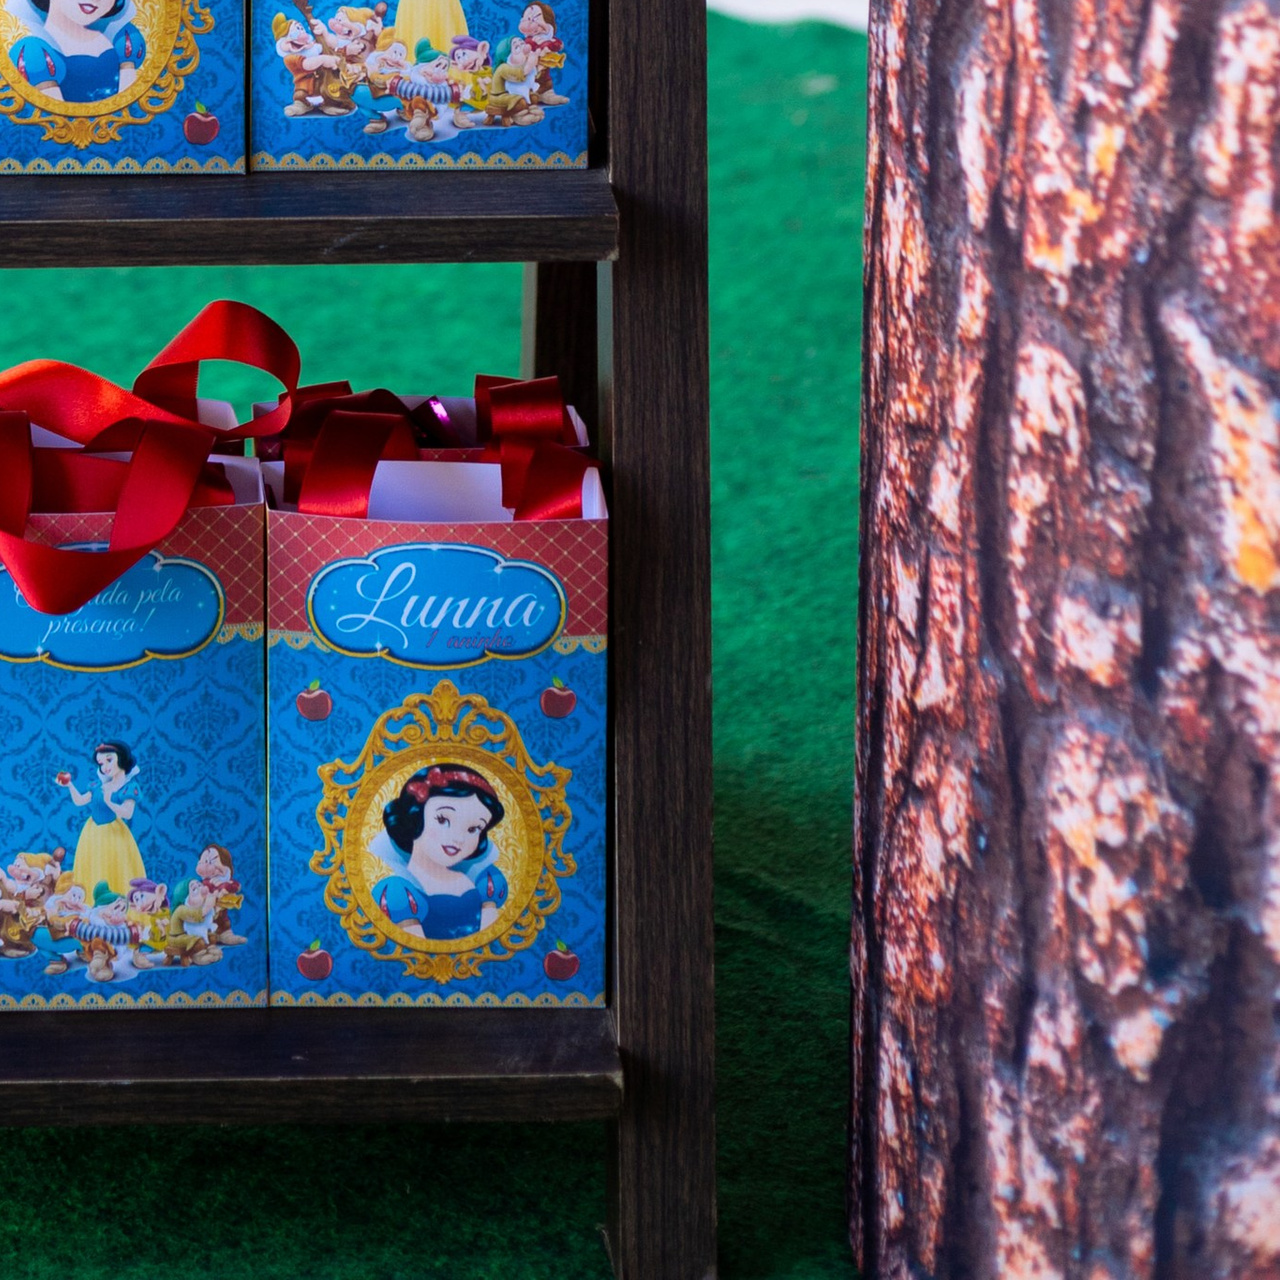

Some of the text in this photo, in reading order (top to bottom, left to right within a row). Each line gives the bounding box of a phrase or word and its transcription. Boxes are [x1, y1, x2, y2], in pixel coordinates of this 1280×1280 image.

[133, 578, 184, 614] pela
[336, 562, 545, 649] Lunna
[41, 607, 157, 643] presença!
